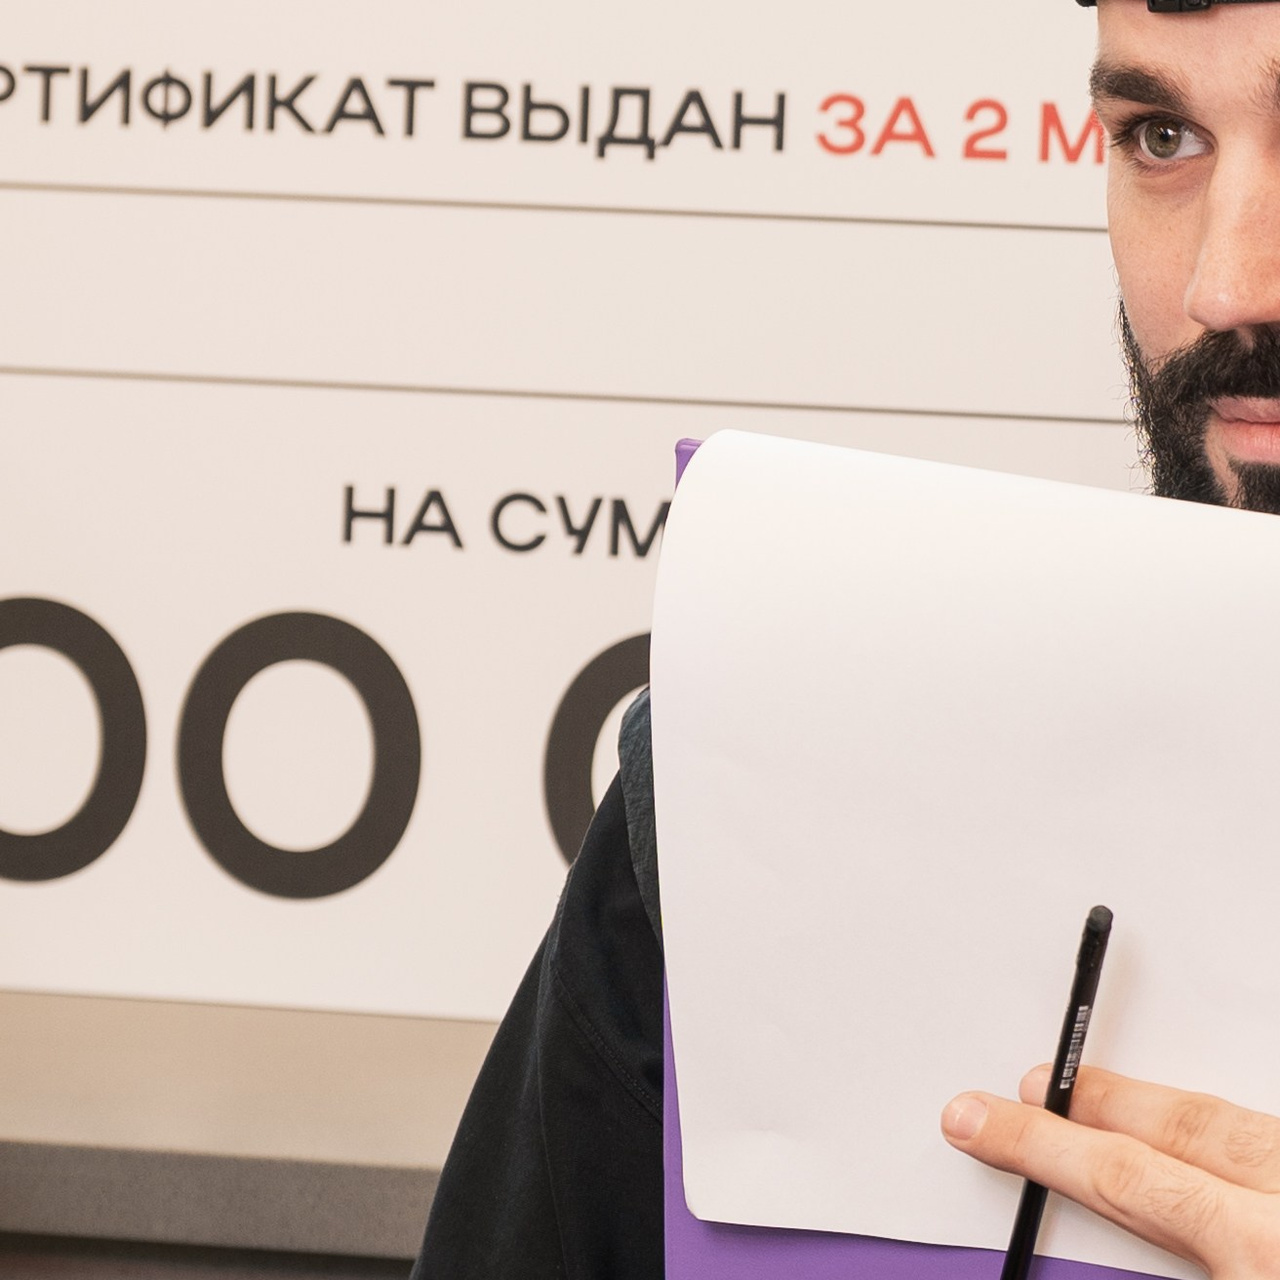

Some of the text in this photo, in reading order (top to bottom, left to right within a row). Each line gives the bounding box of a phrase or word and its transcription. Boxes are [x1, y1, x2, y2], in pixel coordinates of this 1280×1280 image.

[461, 80, 786, 160] ВЫДАН
[815, 92, 936, 158] ЗА
[961, 97, 1008, 161] 2
[342, 484, 464, 549] НА
